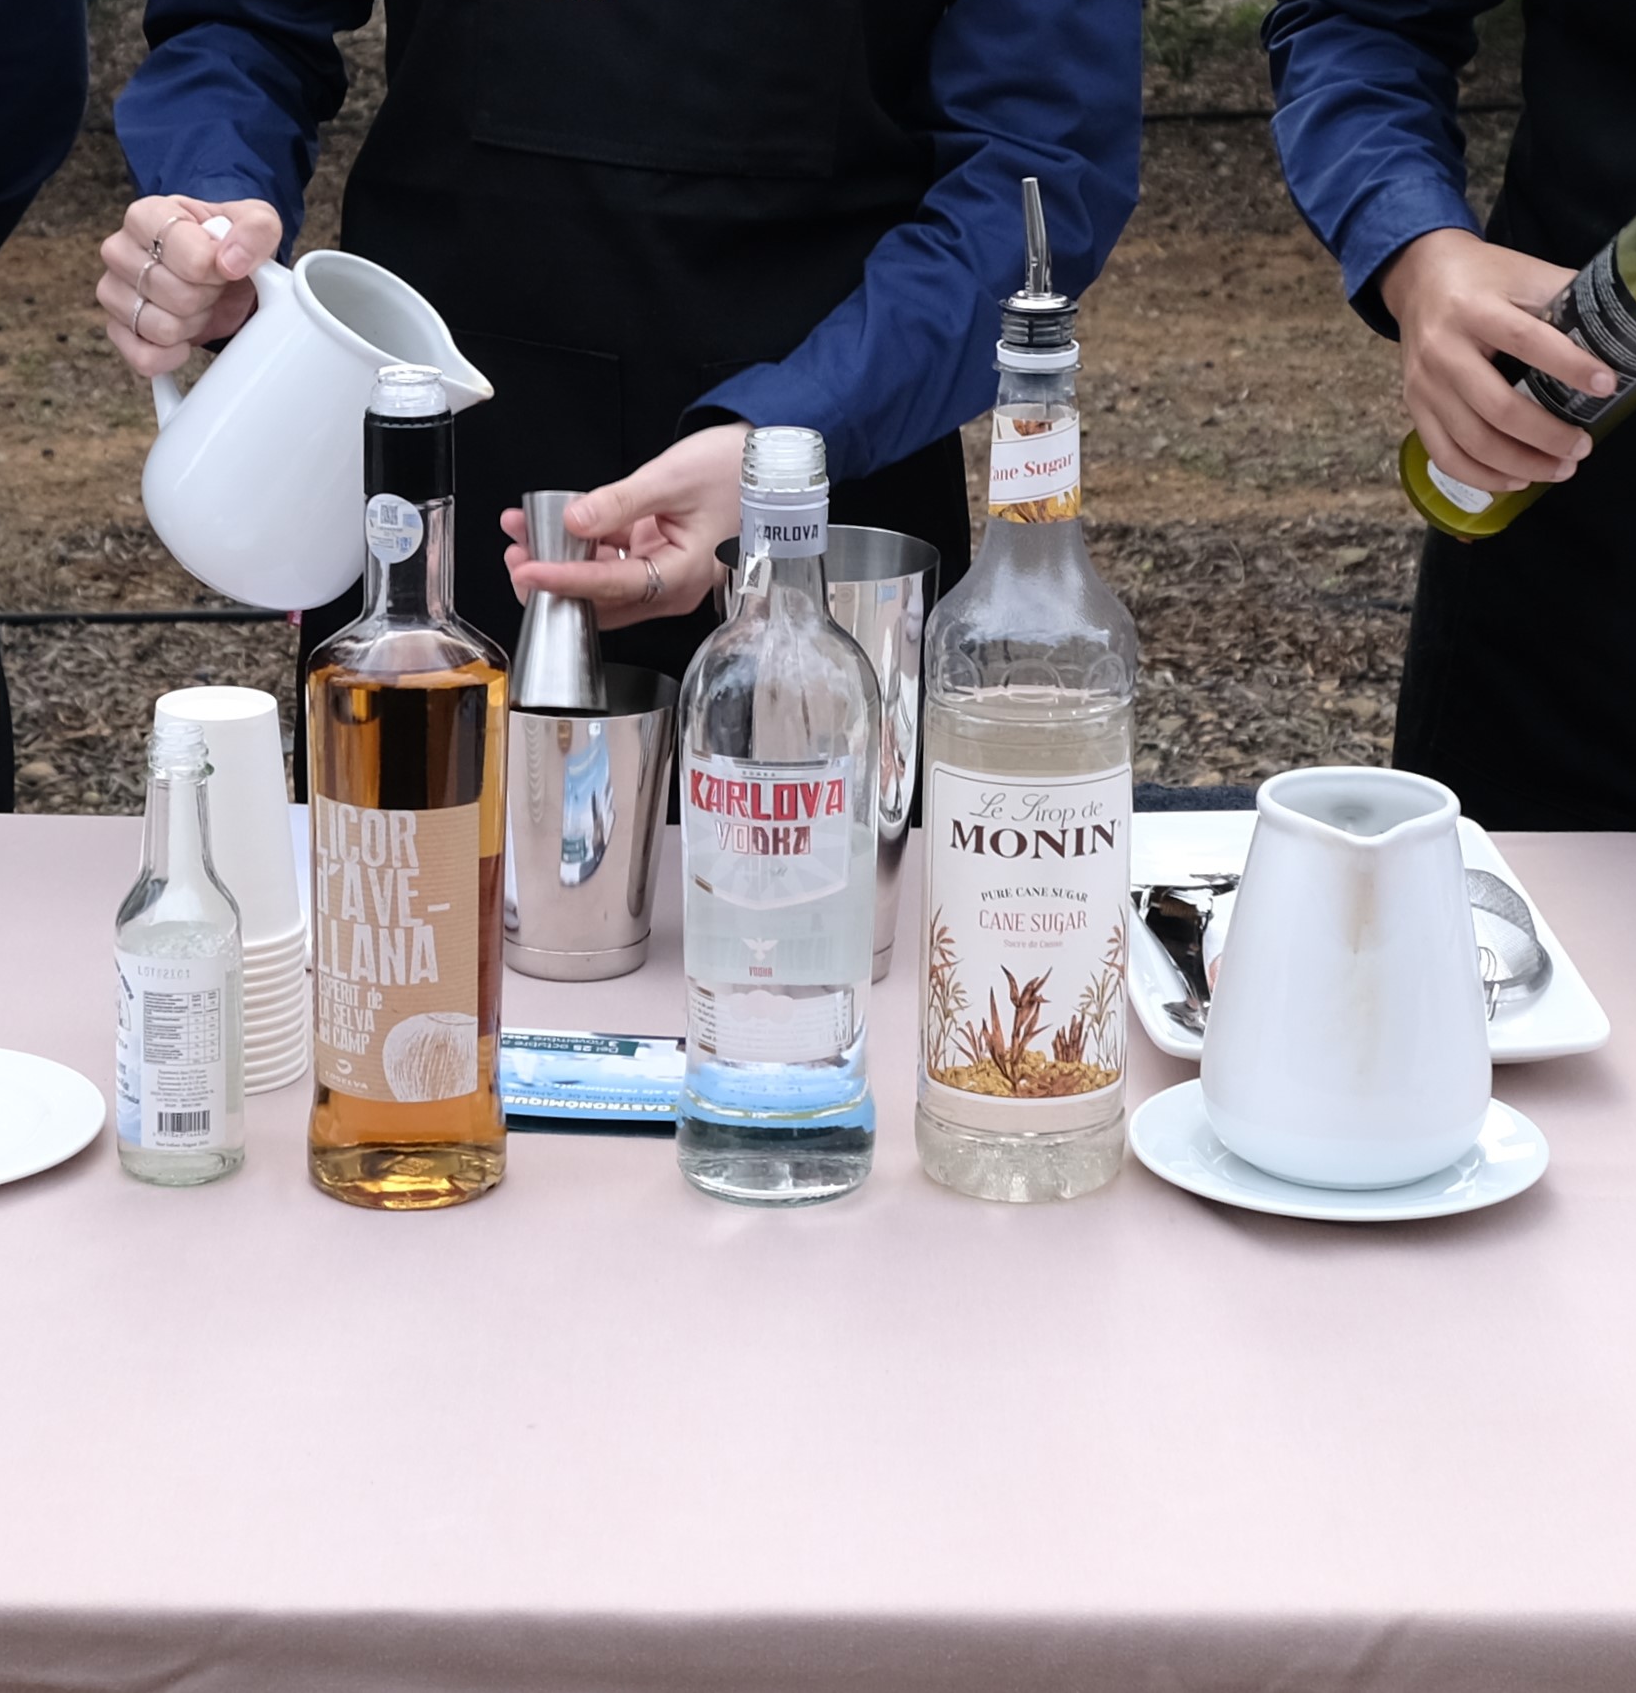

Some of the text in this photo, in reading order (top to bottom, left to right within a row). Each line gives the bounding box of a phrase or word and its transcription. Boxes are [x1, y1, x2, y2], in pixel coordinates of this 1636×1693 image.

[1023, 453, 1074, 477] Sugar
[754, 524, 819, 541] KARLOVA
[690, 768, 846, 821] KARLOVA
[969, 792, 1103, 828] Le Sirop de
[317, 801, 420, 868] LICOR
[715, 819, 811, 856] VODKA
[950, 819, 1117, 860] MONIN
[981, 886, 1088, 904] PURE CANE SUGAR
[979, 909, 1087, 935] CANE SUGAR
[317, 912, 439, 986] LLANA
[749, 966, 773, 978] VODKA
[367, 986, 383, 1010] de
[333, 1002, 375, 1033] SELVA
[333, 1027, 371, 1055] CAMP
